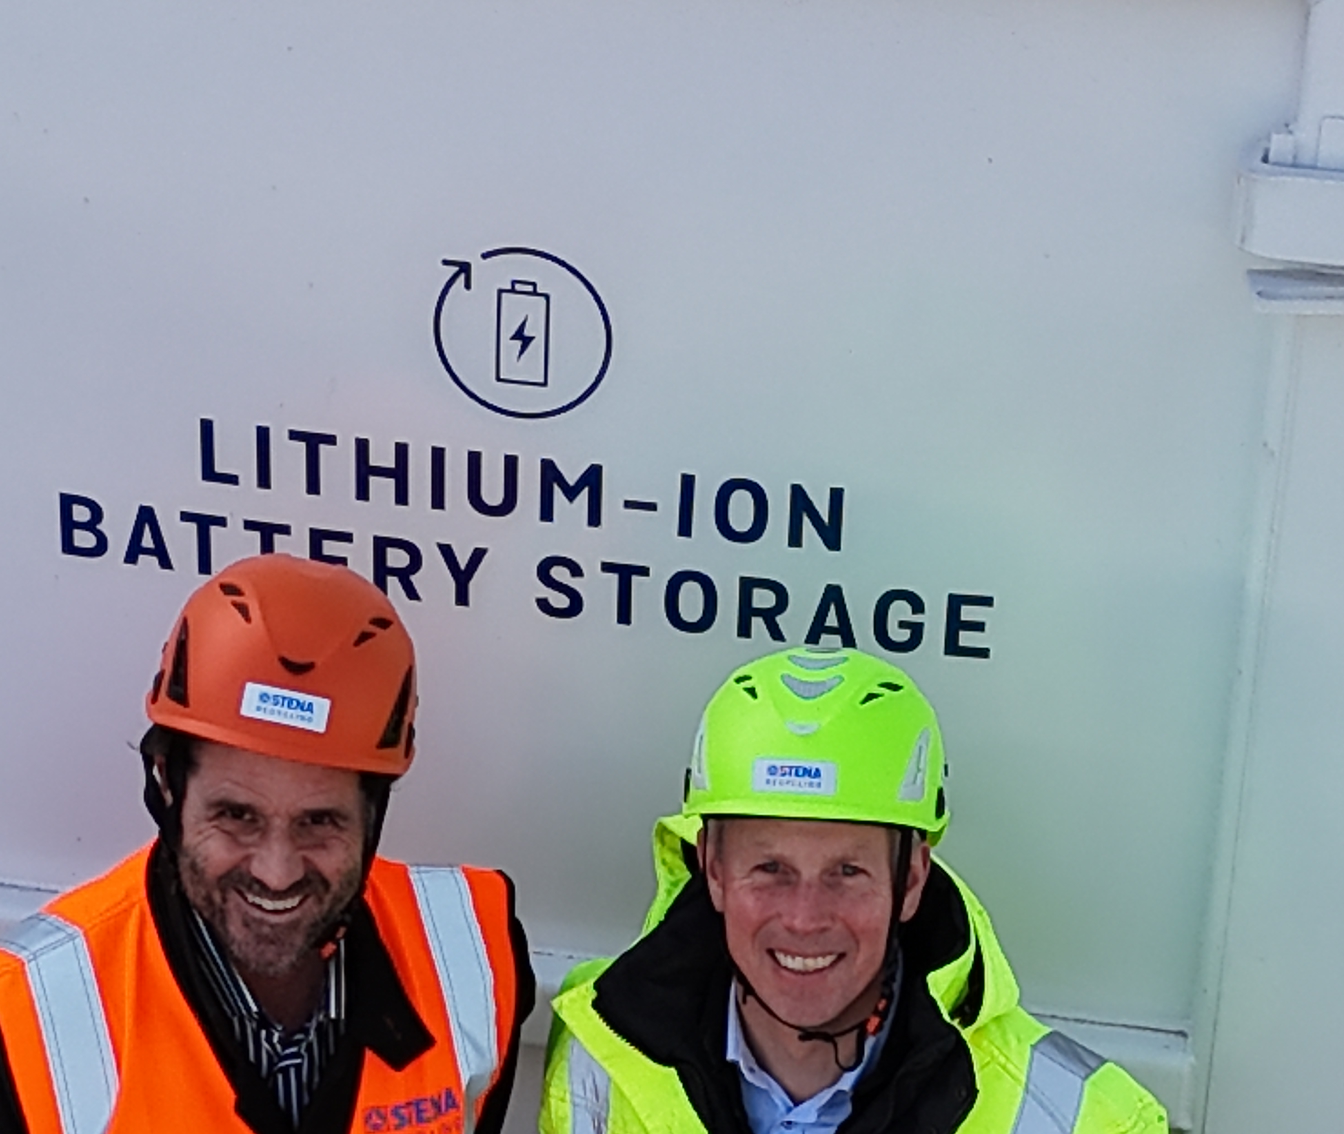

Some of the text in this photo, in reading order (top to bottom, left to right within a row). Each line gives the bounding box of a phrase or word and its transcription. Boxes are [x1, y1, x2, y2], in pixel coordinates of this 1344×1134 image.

[199, 418, 845, 552] LITHIUM-ION
[59, 492, 995, 659] BATTERY STORAGE
